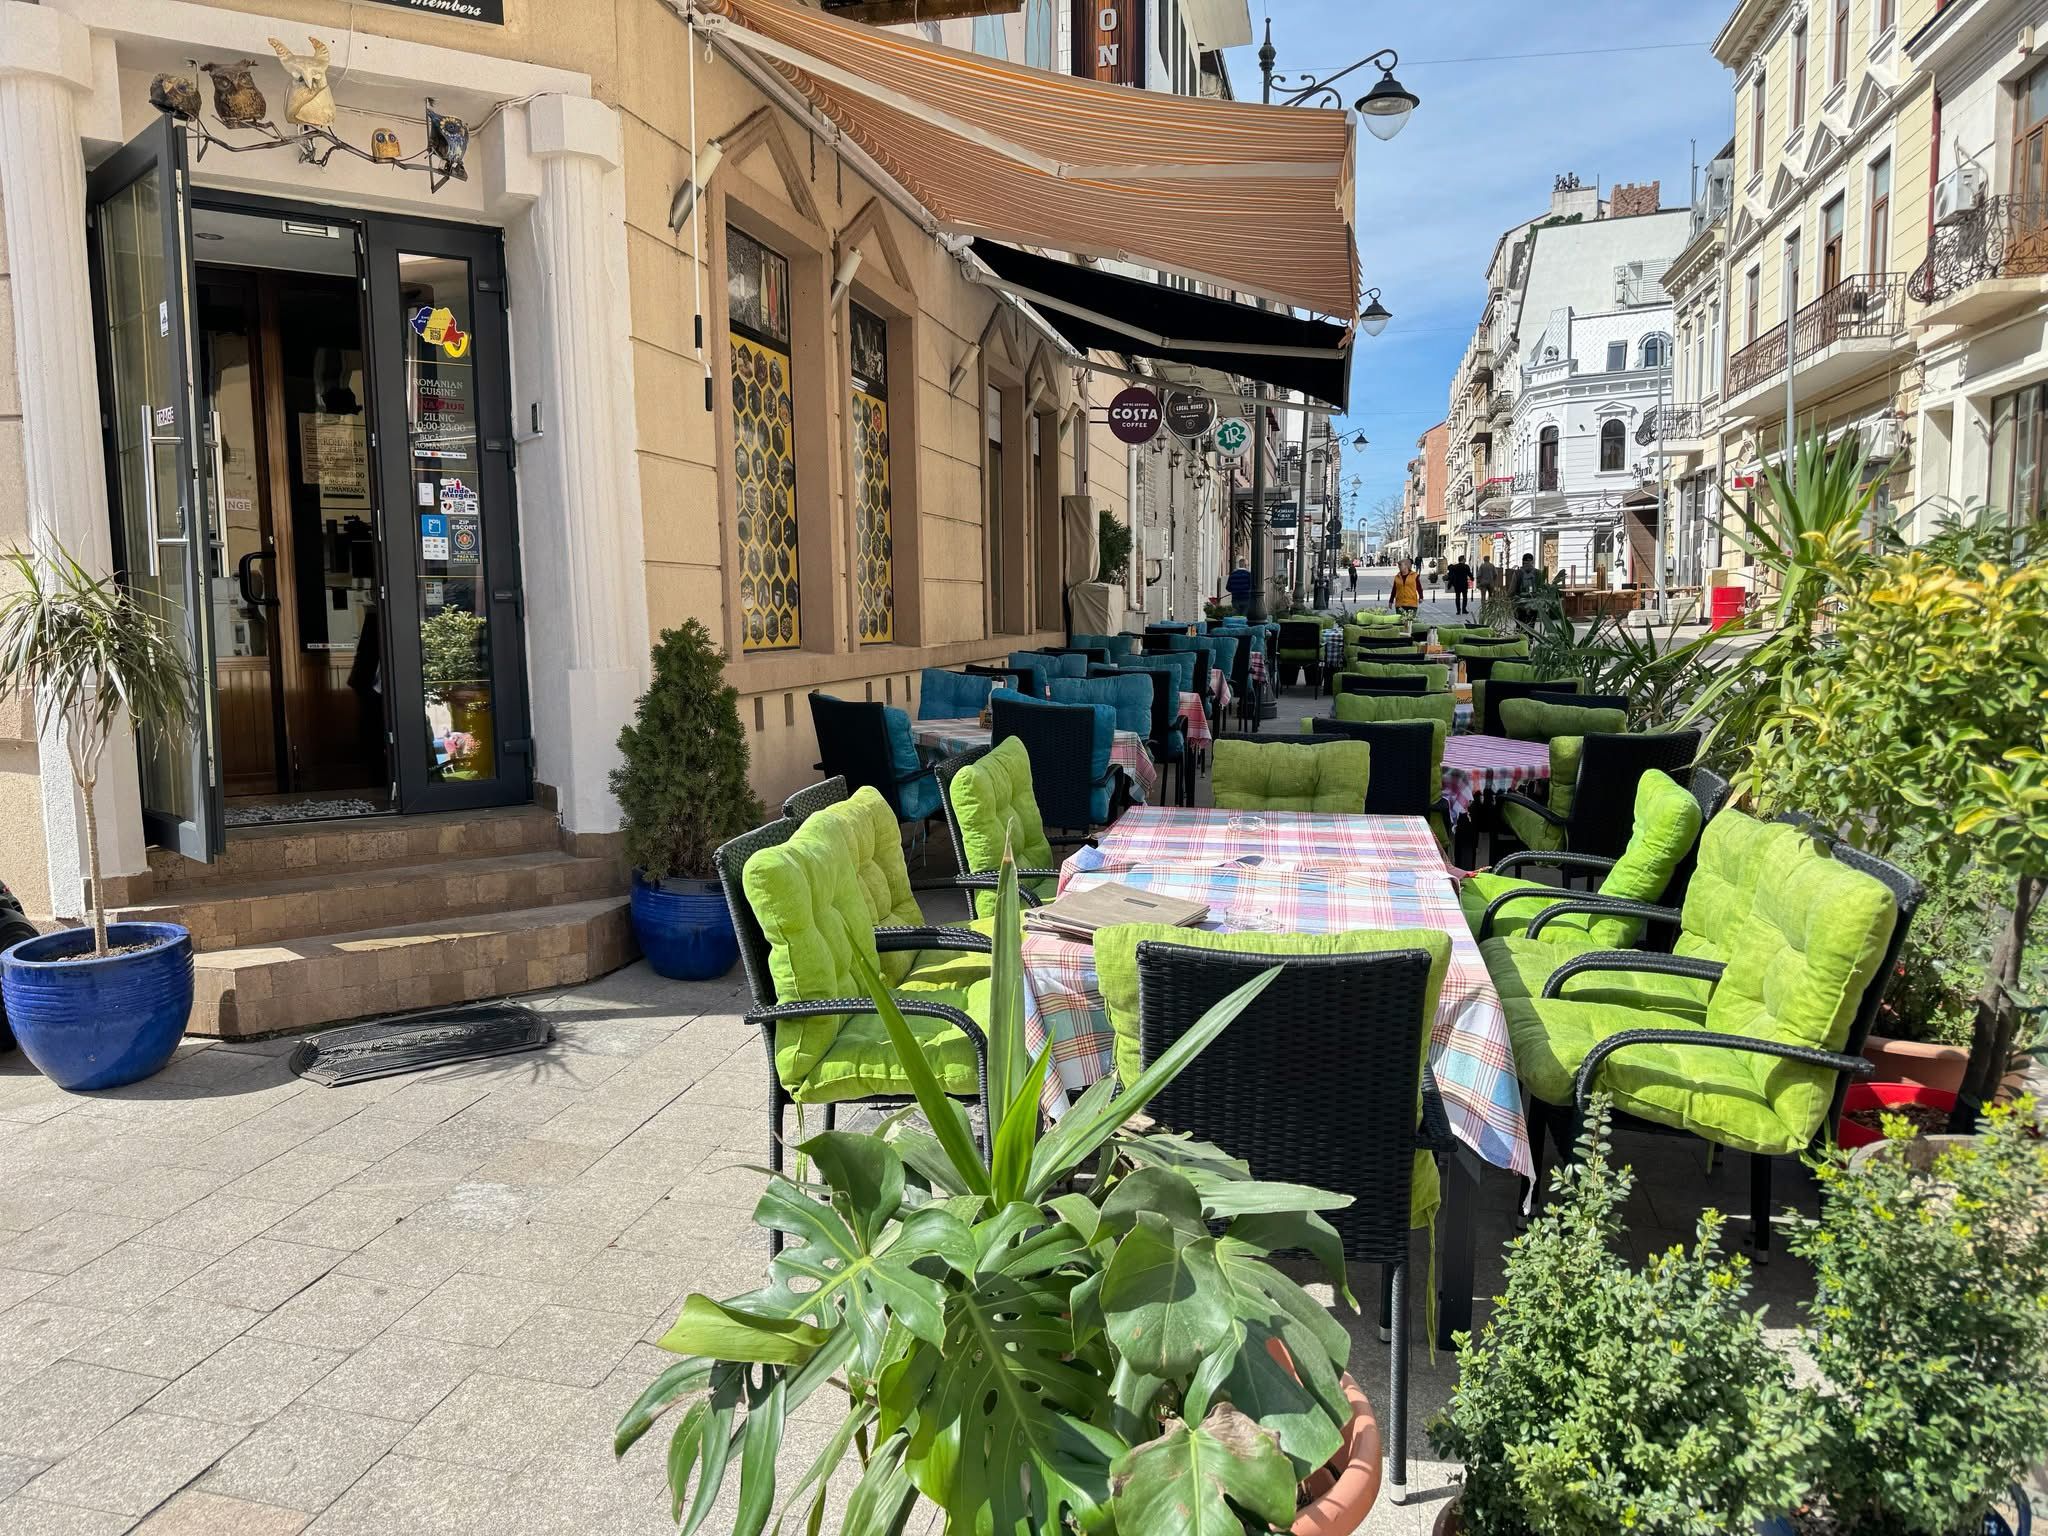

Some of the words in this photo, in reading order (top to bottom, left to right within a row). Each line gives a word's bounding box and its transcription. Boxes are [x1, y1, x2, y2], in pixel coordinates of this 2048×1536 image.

[413, 378, 463, 389] ROMANIAN
[420, 387, 457, 397] CUISINE
[157, 408, 174, 425] TRAGE
[423, 412, 456, 423] ZILNIC
[1112, 408, 1158, 421] COSTA
[415, 421, 466, 432] 0:00-23:00
[442, 491, 477, 500] Mergem
[448, 486, 470, 495] Unde
